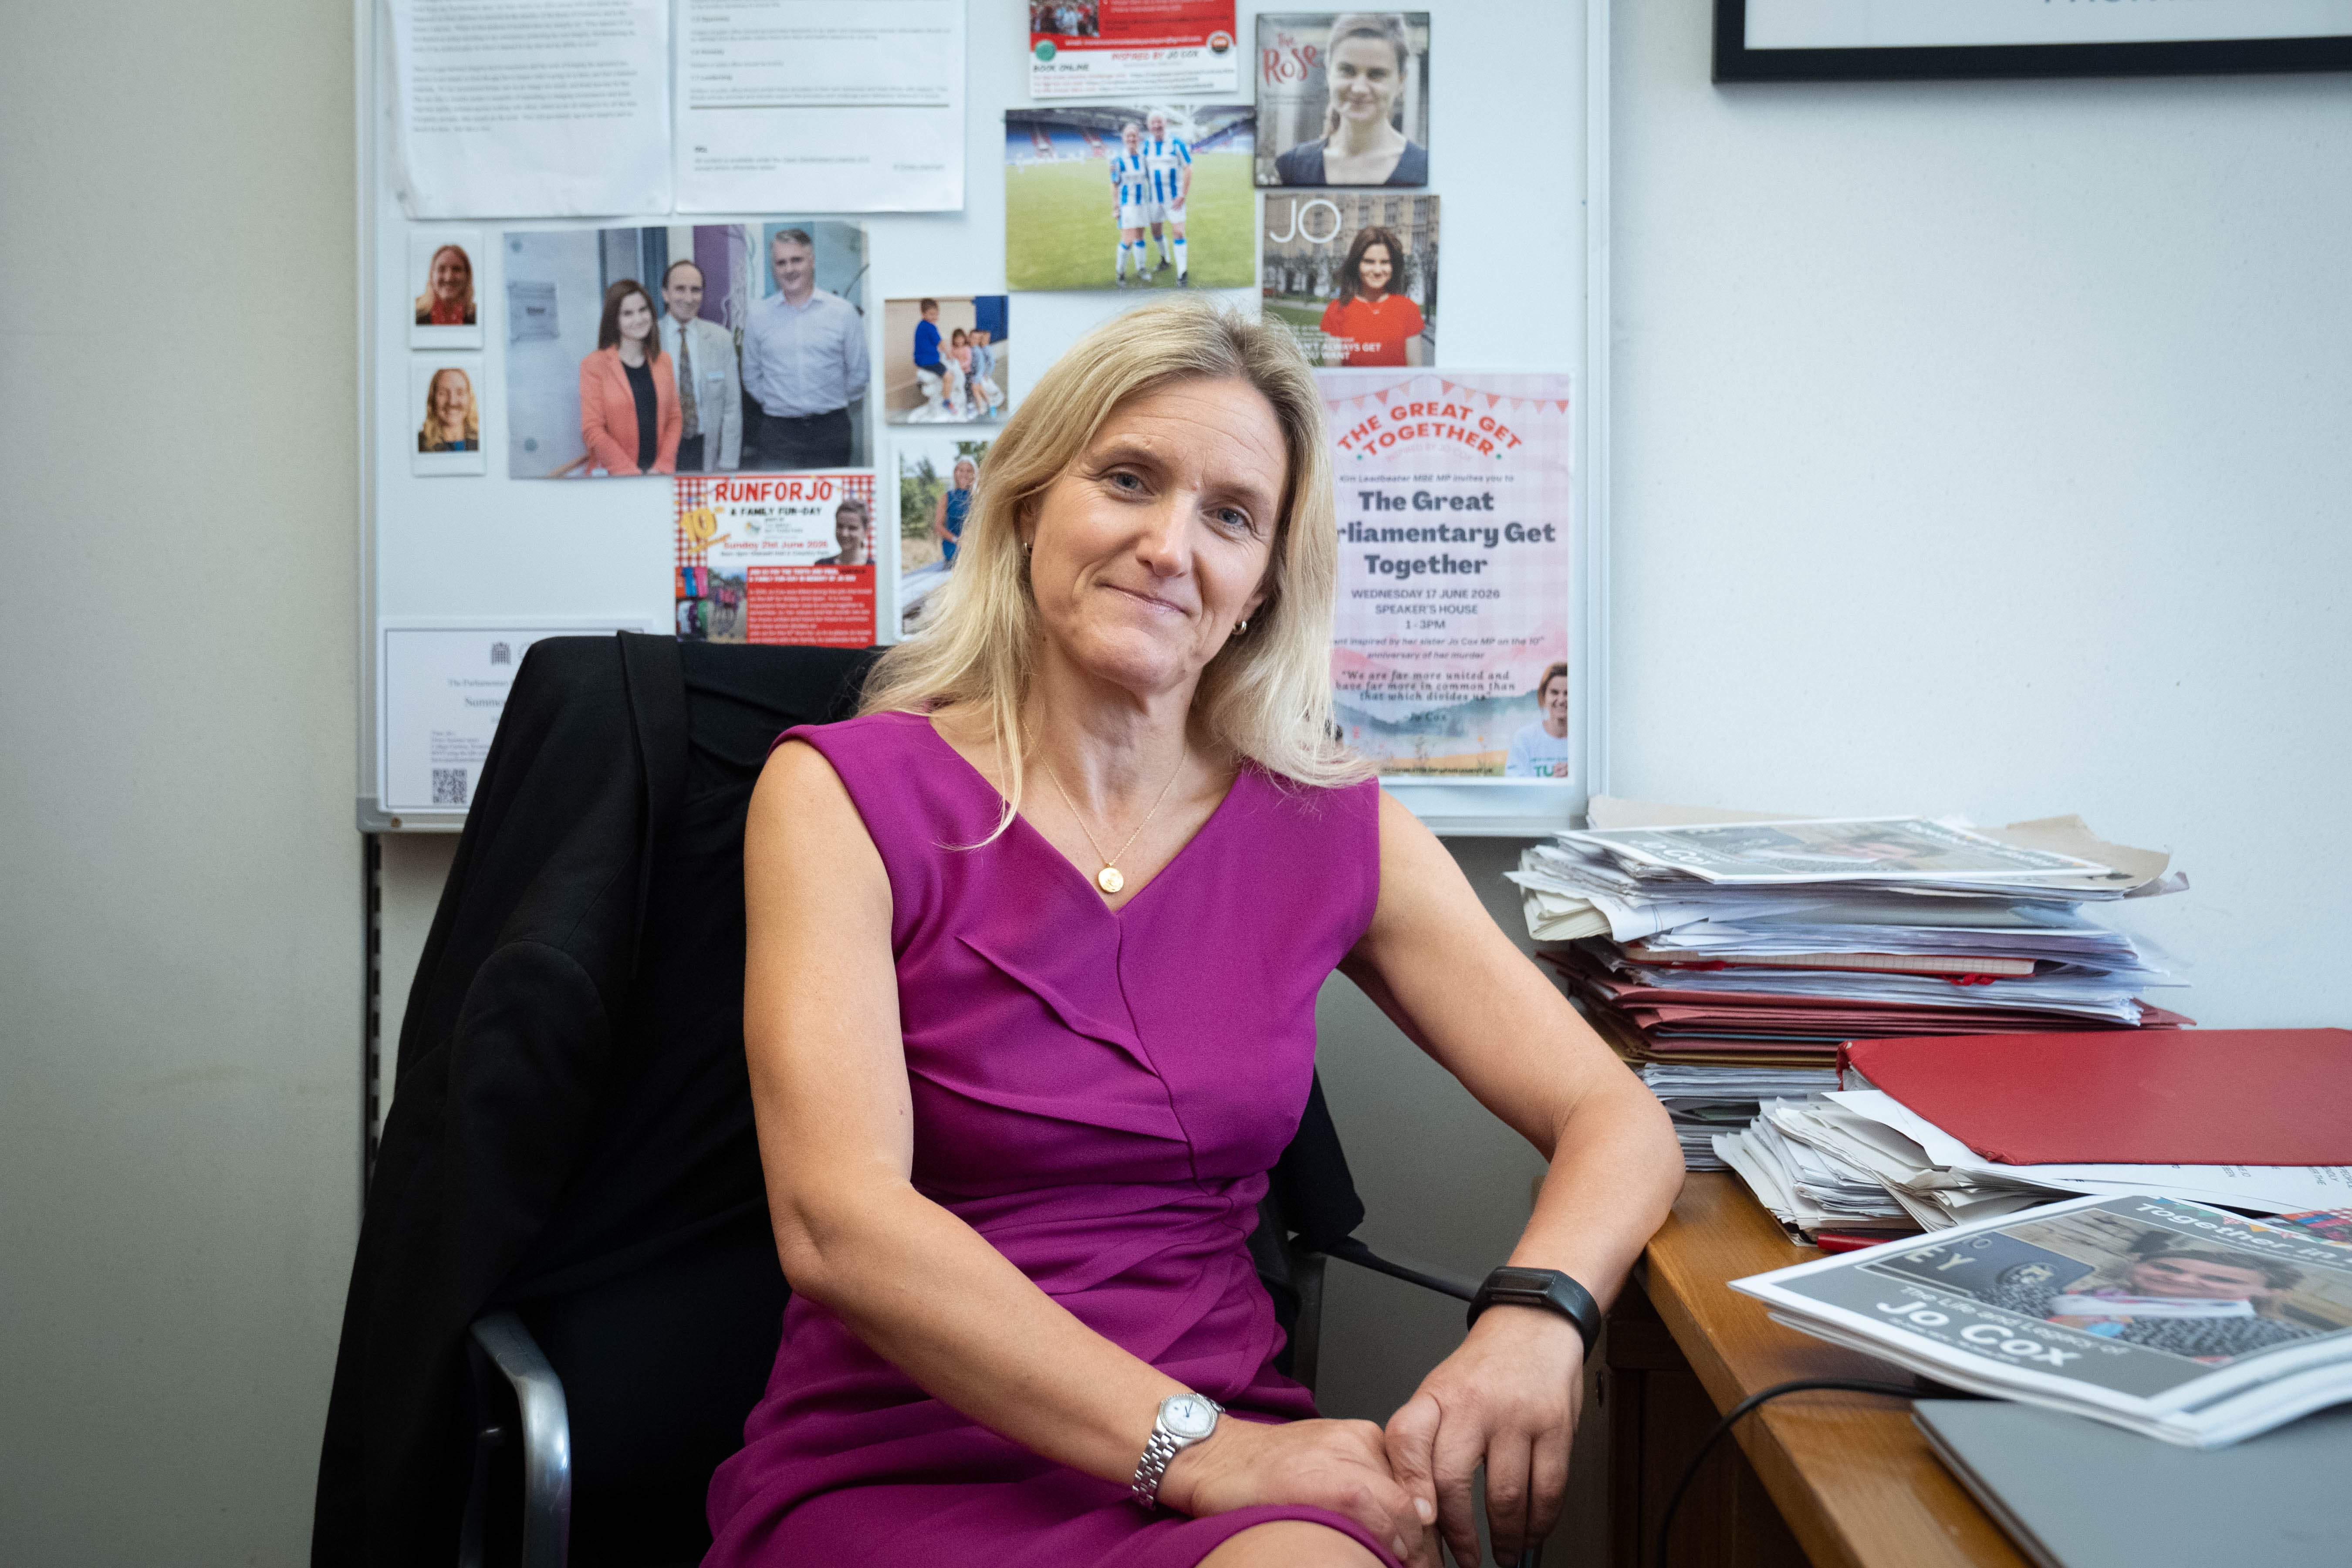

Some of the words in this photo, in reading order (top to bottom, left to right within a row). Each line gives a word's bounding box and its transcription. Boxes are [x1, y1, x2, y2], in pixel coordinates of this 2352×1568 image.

[1269, 199, 1342, 244] JO
[1362, 342, 1381, 352] GET
[1337, 415, 1382, 450] THE
[1390, 402, 1473, 422] GREAT
[1478, 416, 1522, 449] GET
[1362, 422, 1494, 456] TOGETHER
[1358, 474, 1410, 483] Leadbeater
[1453, 474, 1483, 482] invites
[1486, 476, 1501, 484] you
[1358, 490, 1406, 511] The
[1412, 490, 1494, 511] Great
[741, 507, 774, 515] FAMILY
[778, 506, 822, 515] FUN-DAY
[1337, 521, 1499, 548] rliamentary
[1504, 522, 1555, 543] Get
[1364, 554, 1488, 579] Together
[1352, 589, 1423, 598] WEDNESDAY
[1426, 589, 1436, 598] 17
[1440, 589, 1468, 599] JUNE
[1471, 589, 1500, 599] 2026
[1375, 604, 1436, 614] SPEAKER'S
[1439, 604, 1478, 614] HOUSE
[1406, 620, 1411, 629] 1
[1419, 620, 1446, 629] 3PM
[1351, 637, 1387, 647] inspired
[1389, 638, 1400, 647] by
[1367, 652, 1419, 660] anniversary
[1391, 671, 1408, 682] far
[1446, 671, 1484, 680] united
[1487, 671, 1510, 680] and
[1366, 682, 1382, 693] far
[1421, 682, 1432, 690] in
[1488, 682, 1516, 690] than
[1360, 692, 1384, 701] that
[1388, 692, 1423, 701] which
[1426, 692, 1469, 701] divides
[2136, 1203, 2295, 1248] Together
[1876, 1301, 1950, 1327] Jo
[1960, 1323, 2083, 1367] Cox
